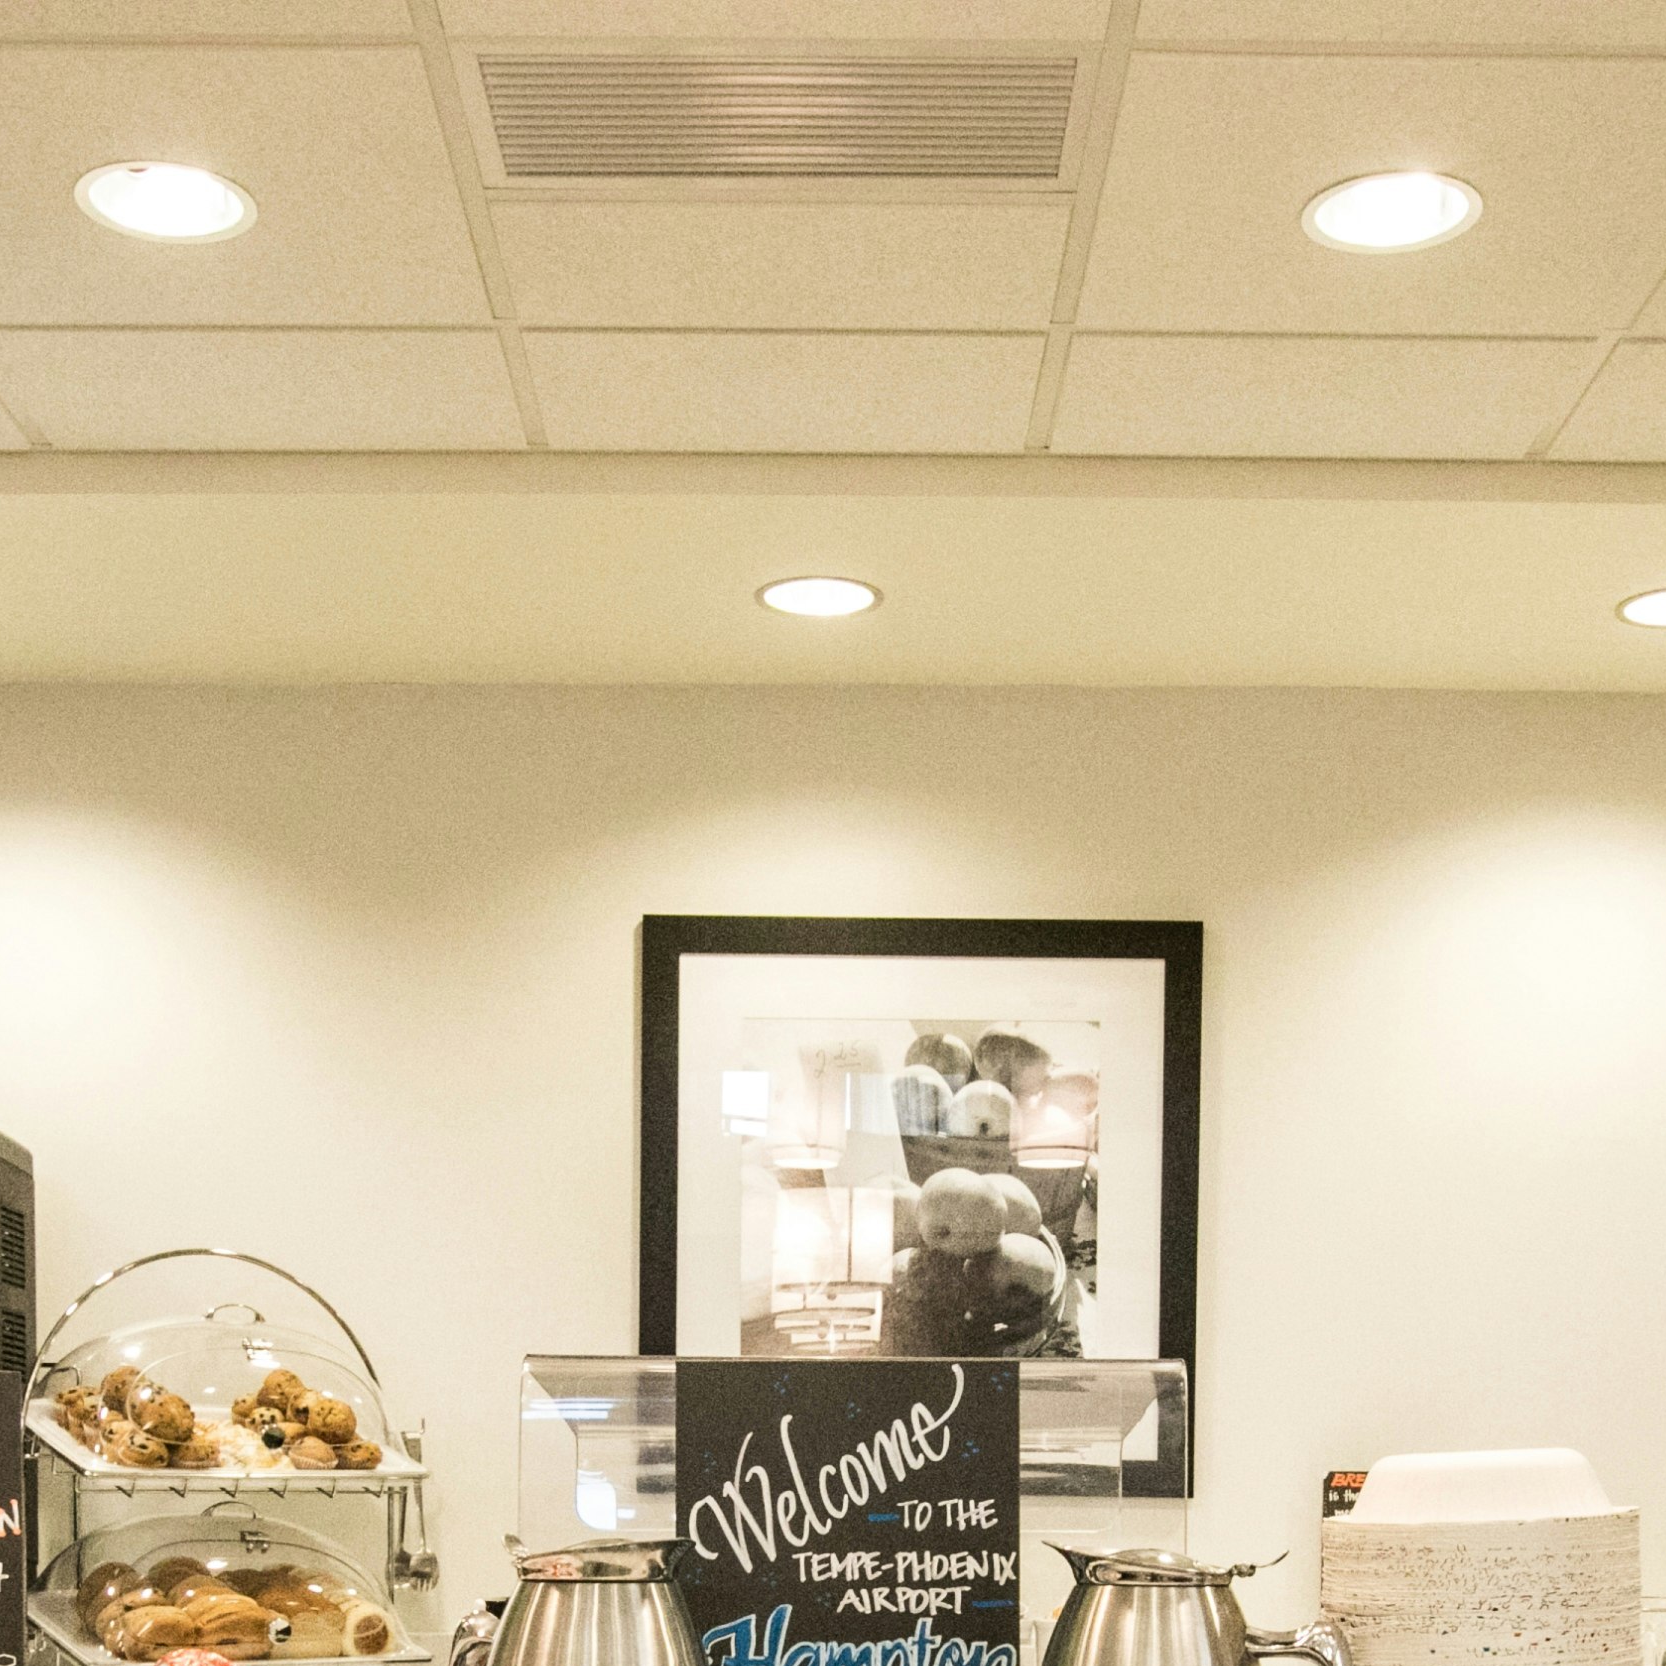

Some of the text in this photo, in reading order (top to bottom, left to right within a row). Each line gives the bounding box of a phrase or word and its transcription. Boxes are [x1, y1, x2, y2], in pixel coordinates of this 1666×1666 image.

[689, 1363, 965, 1573] Welcome
[897, 1498, 998, 1532] TO THE
[837, 1586, 971, 1615] AIRPORT
